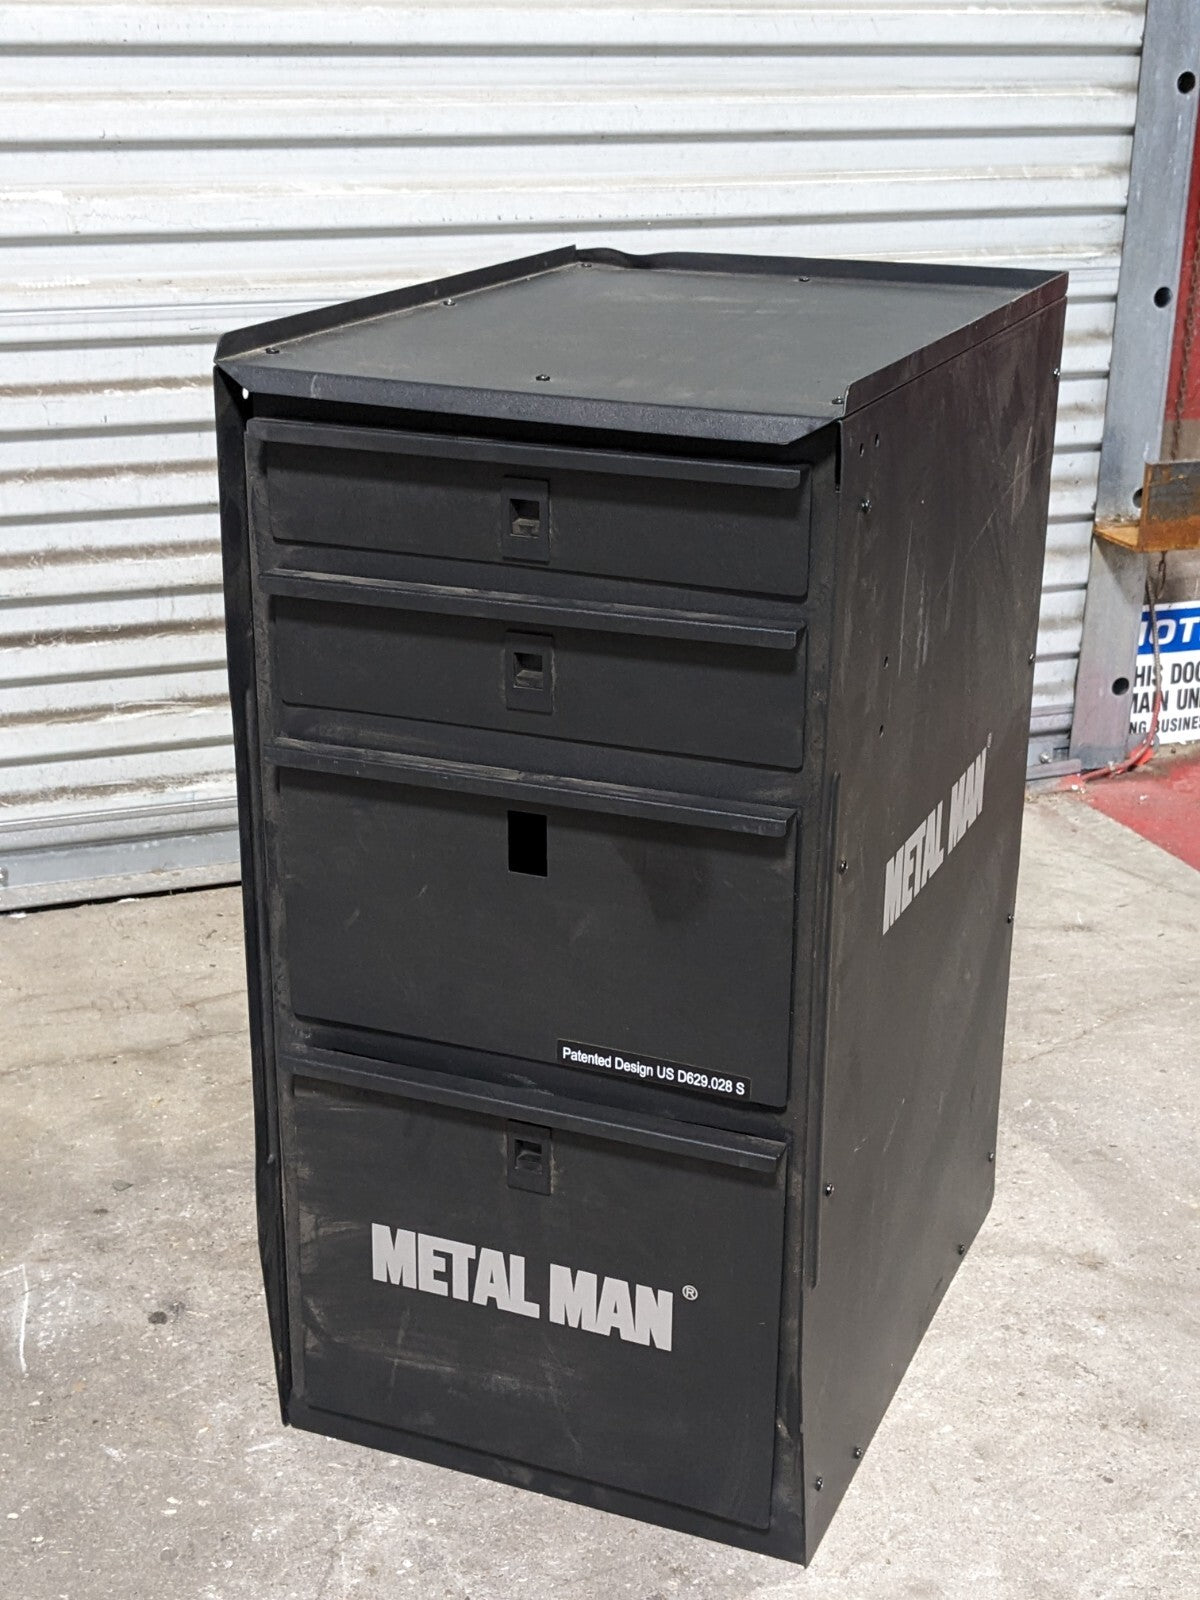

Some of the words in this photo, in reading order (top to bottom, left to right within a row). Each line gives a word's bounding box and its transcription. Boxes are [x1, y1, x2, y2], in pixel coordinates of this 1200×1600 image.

[883, 800, 945, 935] METAL
[947, 747, 987, 855] MAN
[562, 1047, 612, 1068] Patented
[614, 1057, 654, 1078] Design
[656, 1065, 675, 1081] US
[677, 1069, 733, 1093] D629.028
[735, 1082, 746, 1096] S
[371, 1222, 541, 1319] METAL
[549, 1263, 674, 1352] MAN
